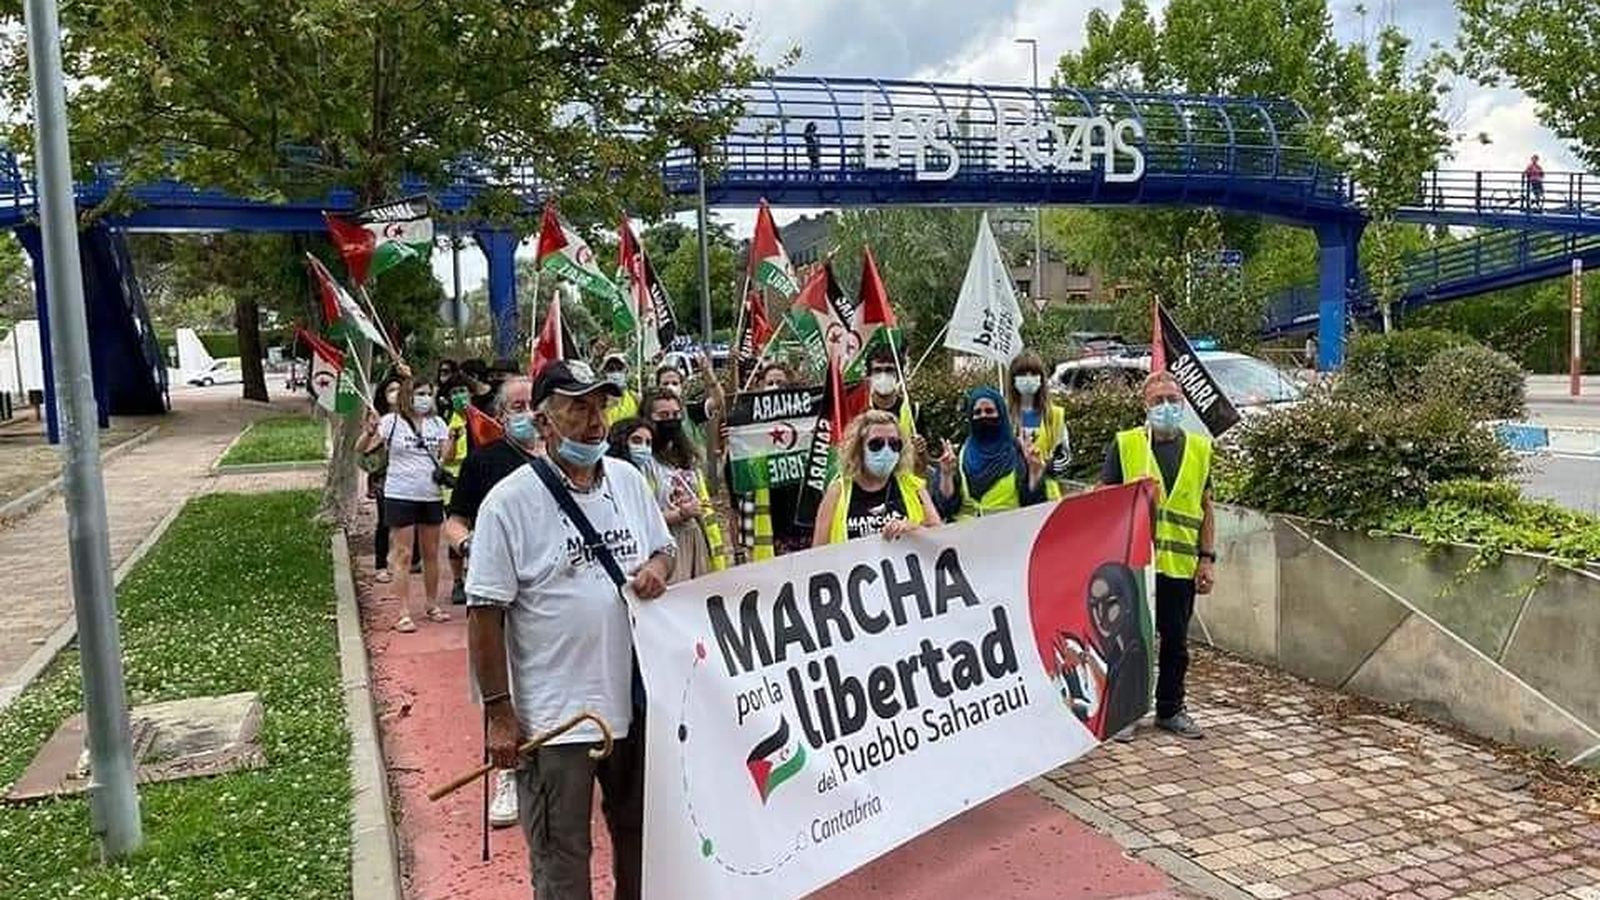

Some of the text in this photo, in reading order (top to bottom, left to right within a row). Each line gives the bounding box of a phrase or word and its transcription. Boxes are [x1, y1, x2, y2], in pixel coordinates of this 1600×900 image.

[864, 90, 1145, 182] LAS ROZAS
[1170, 354, 1218, 413] SAHARA
[567, 529, 632, 551] MCHA
[706, 547, 980, 678] MARCHA
[735, 675, 784, 725] por la
[786, 604, 1020, 750] libertad
[816, 676, 1030, 795] del Pueblo Saharaui
[810, 794, 883, 844] Cantabria
